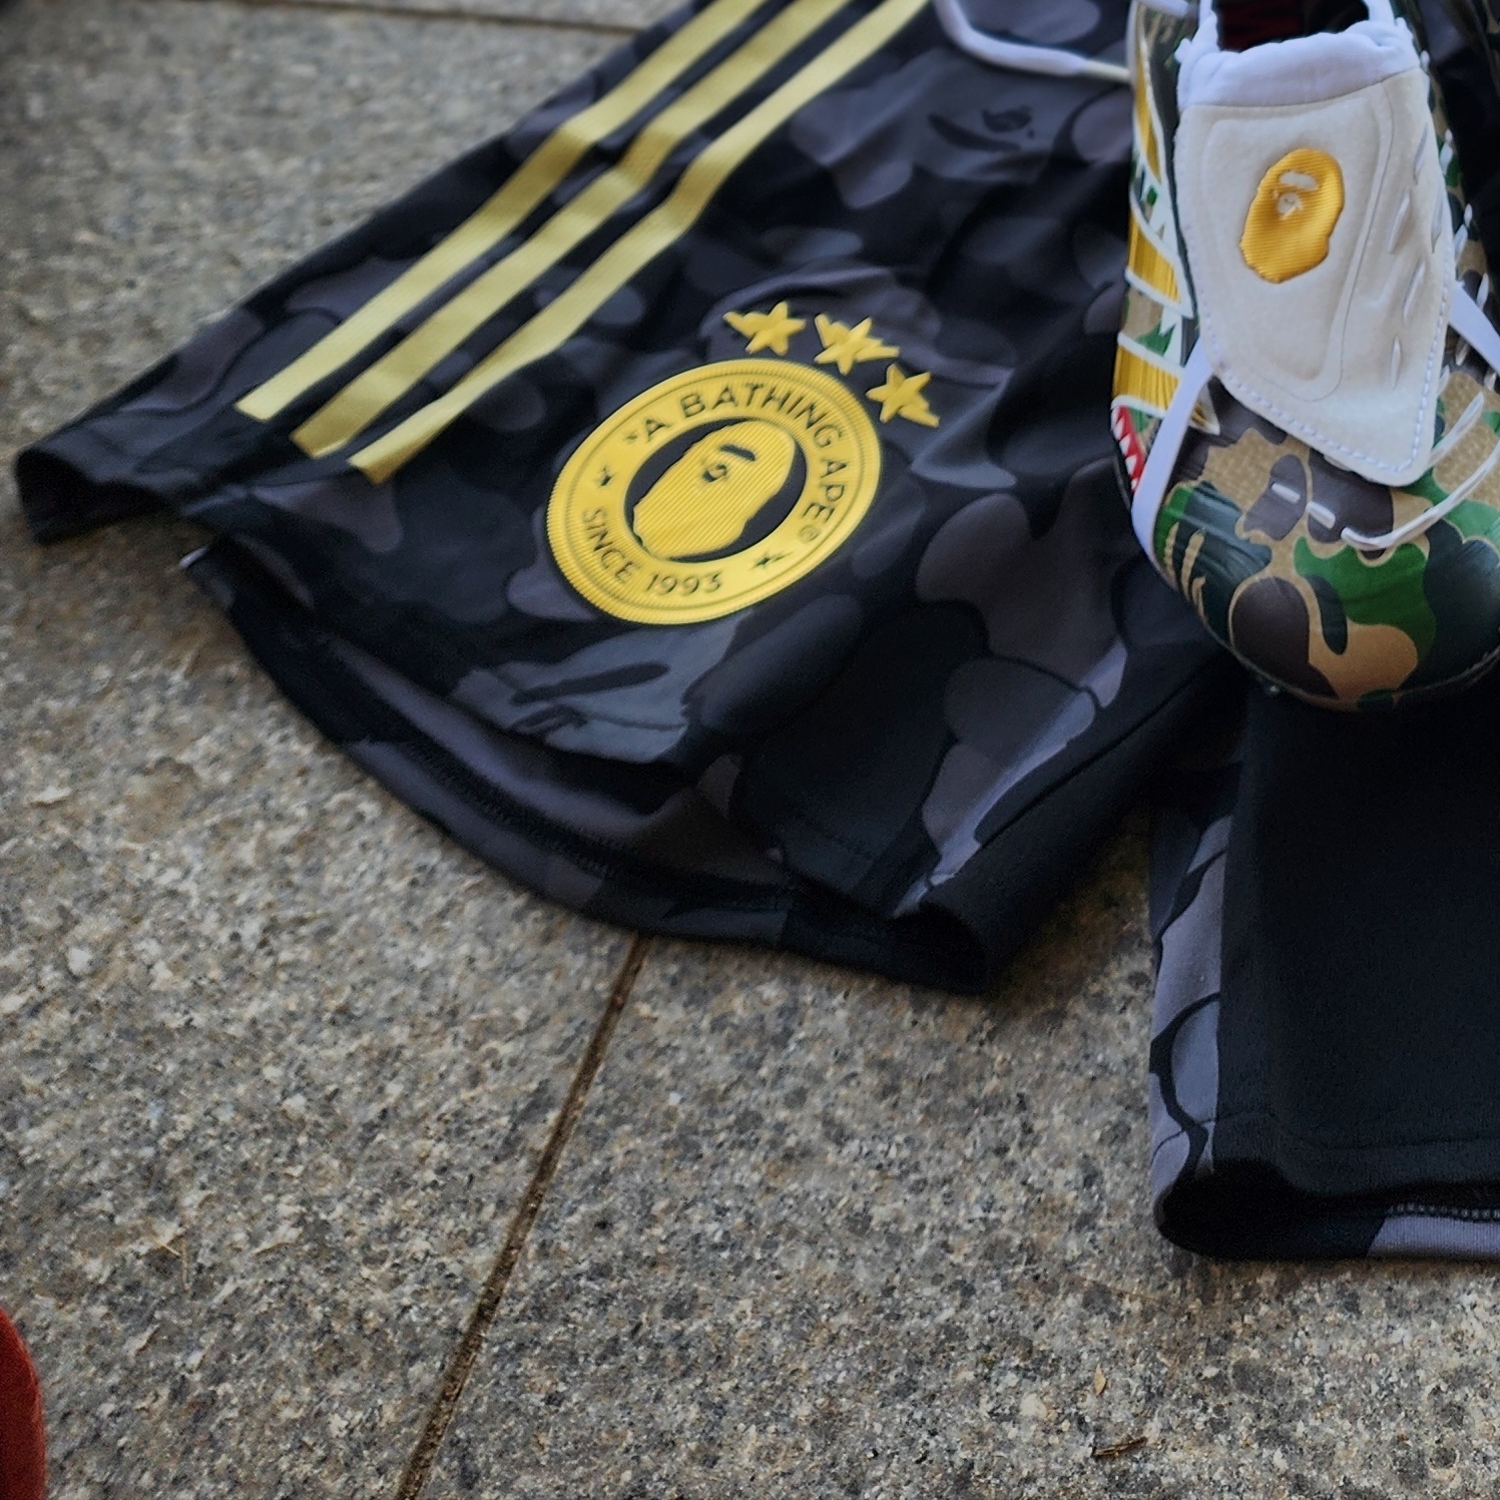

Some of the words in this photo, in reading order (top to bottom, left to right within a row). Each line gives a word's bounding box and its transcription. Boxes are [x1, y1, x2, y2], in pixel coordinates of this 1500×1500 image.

[645, 417, 672, 442] A
[680, 383, 843, 449] BATHING
[582, 506, 639, 585] SINCE
[645, 571, 722, 596] 1993
